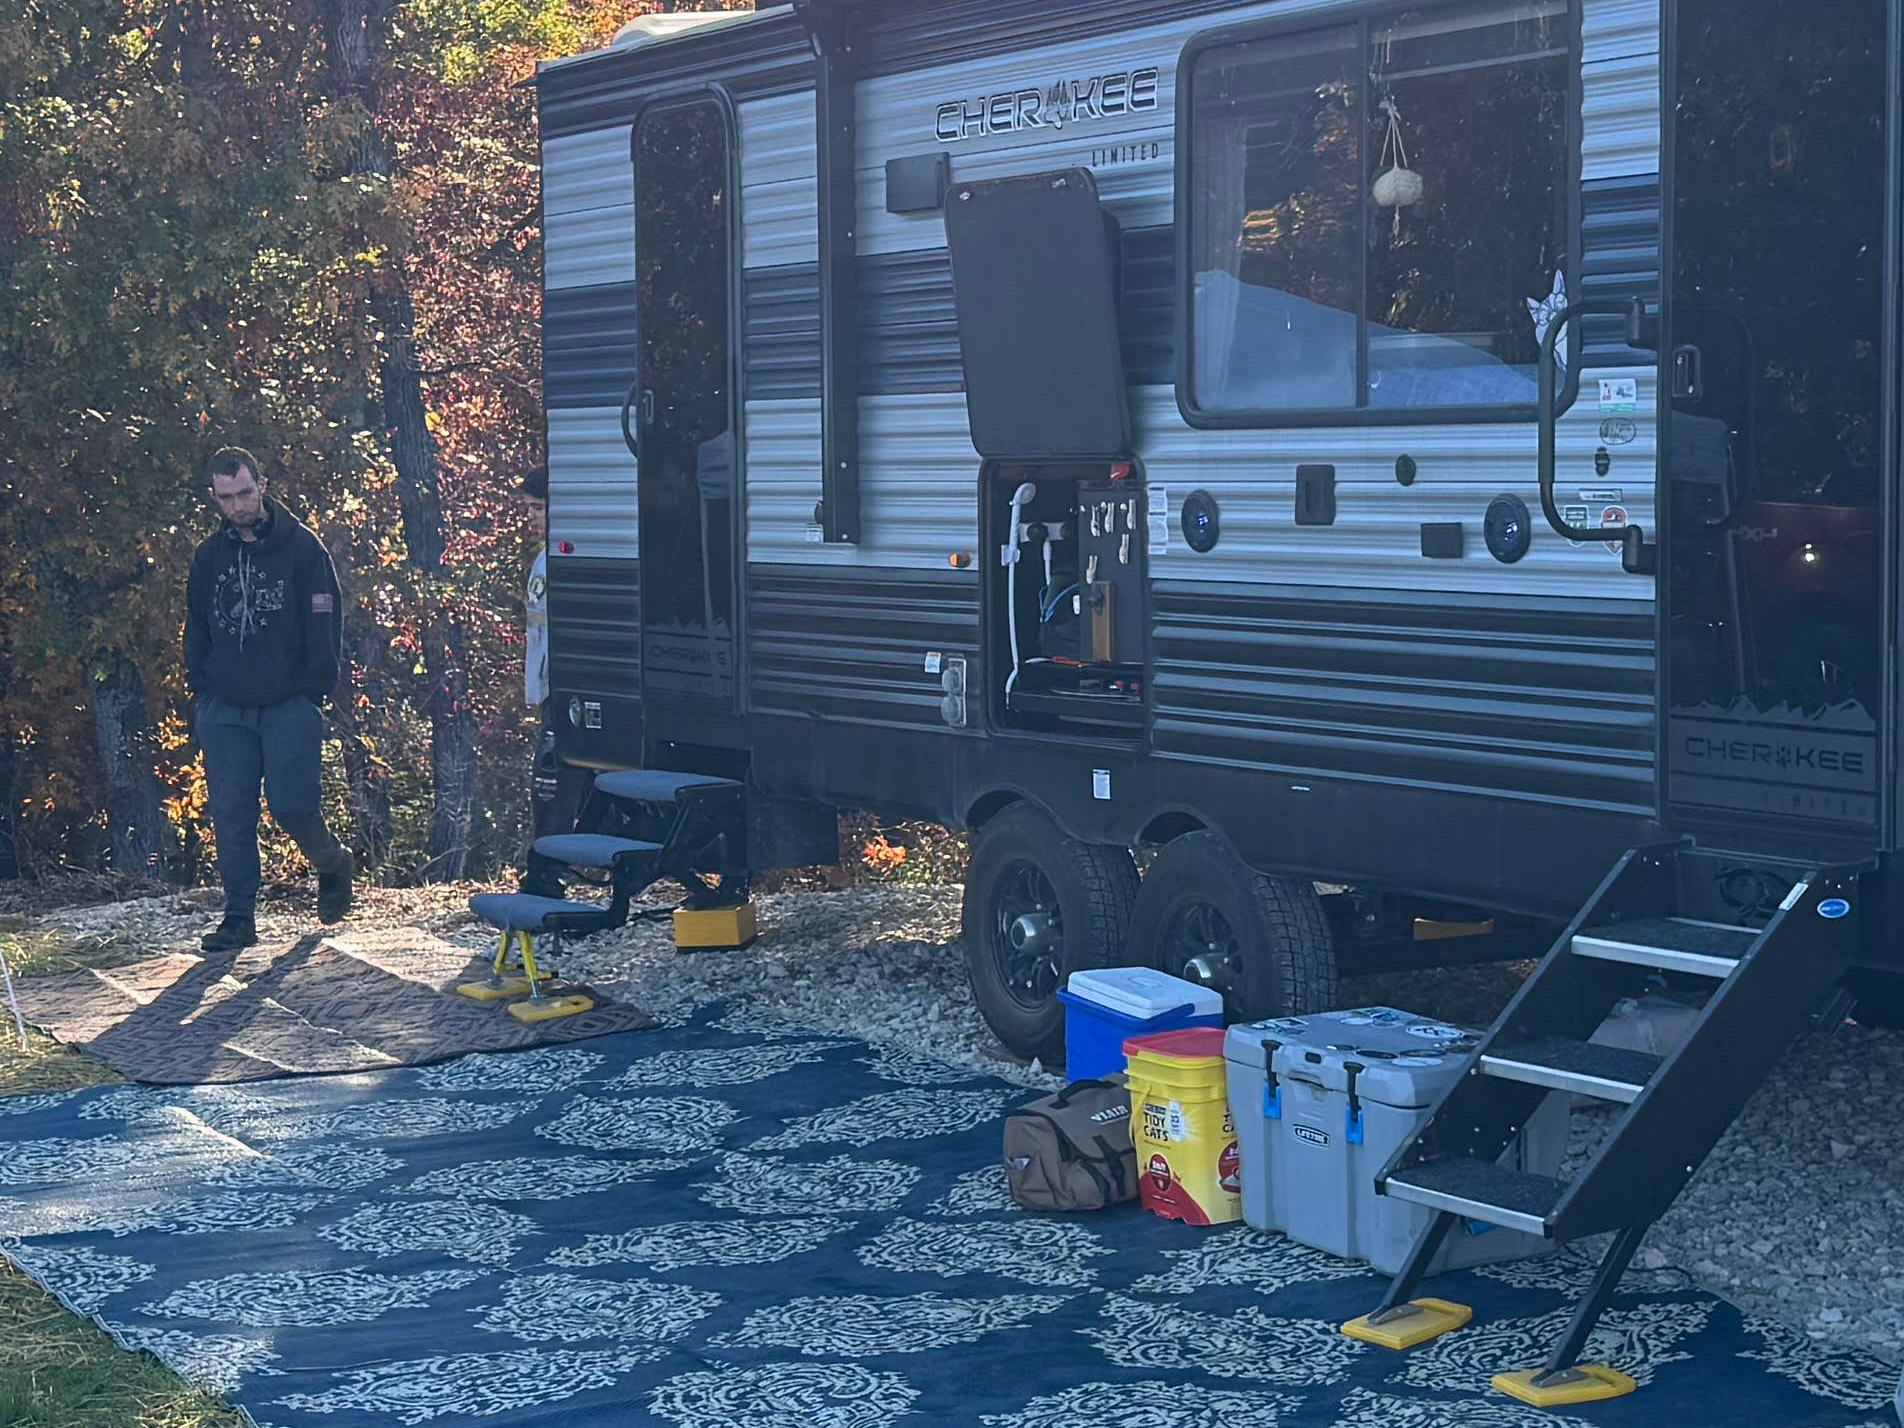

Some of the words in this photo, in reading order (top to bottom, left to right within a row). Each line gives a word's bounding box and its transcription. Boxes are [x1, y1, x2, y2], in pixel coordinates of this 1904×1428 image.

[1091, 142, 1159, 167] LIMITED
[1090, 1105, 1129, 1122] VIAIR
[1143, 1112, 1167, 1127] TIDY
[1143, 1125, 1169, 1141] CATS
